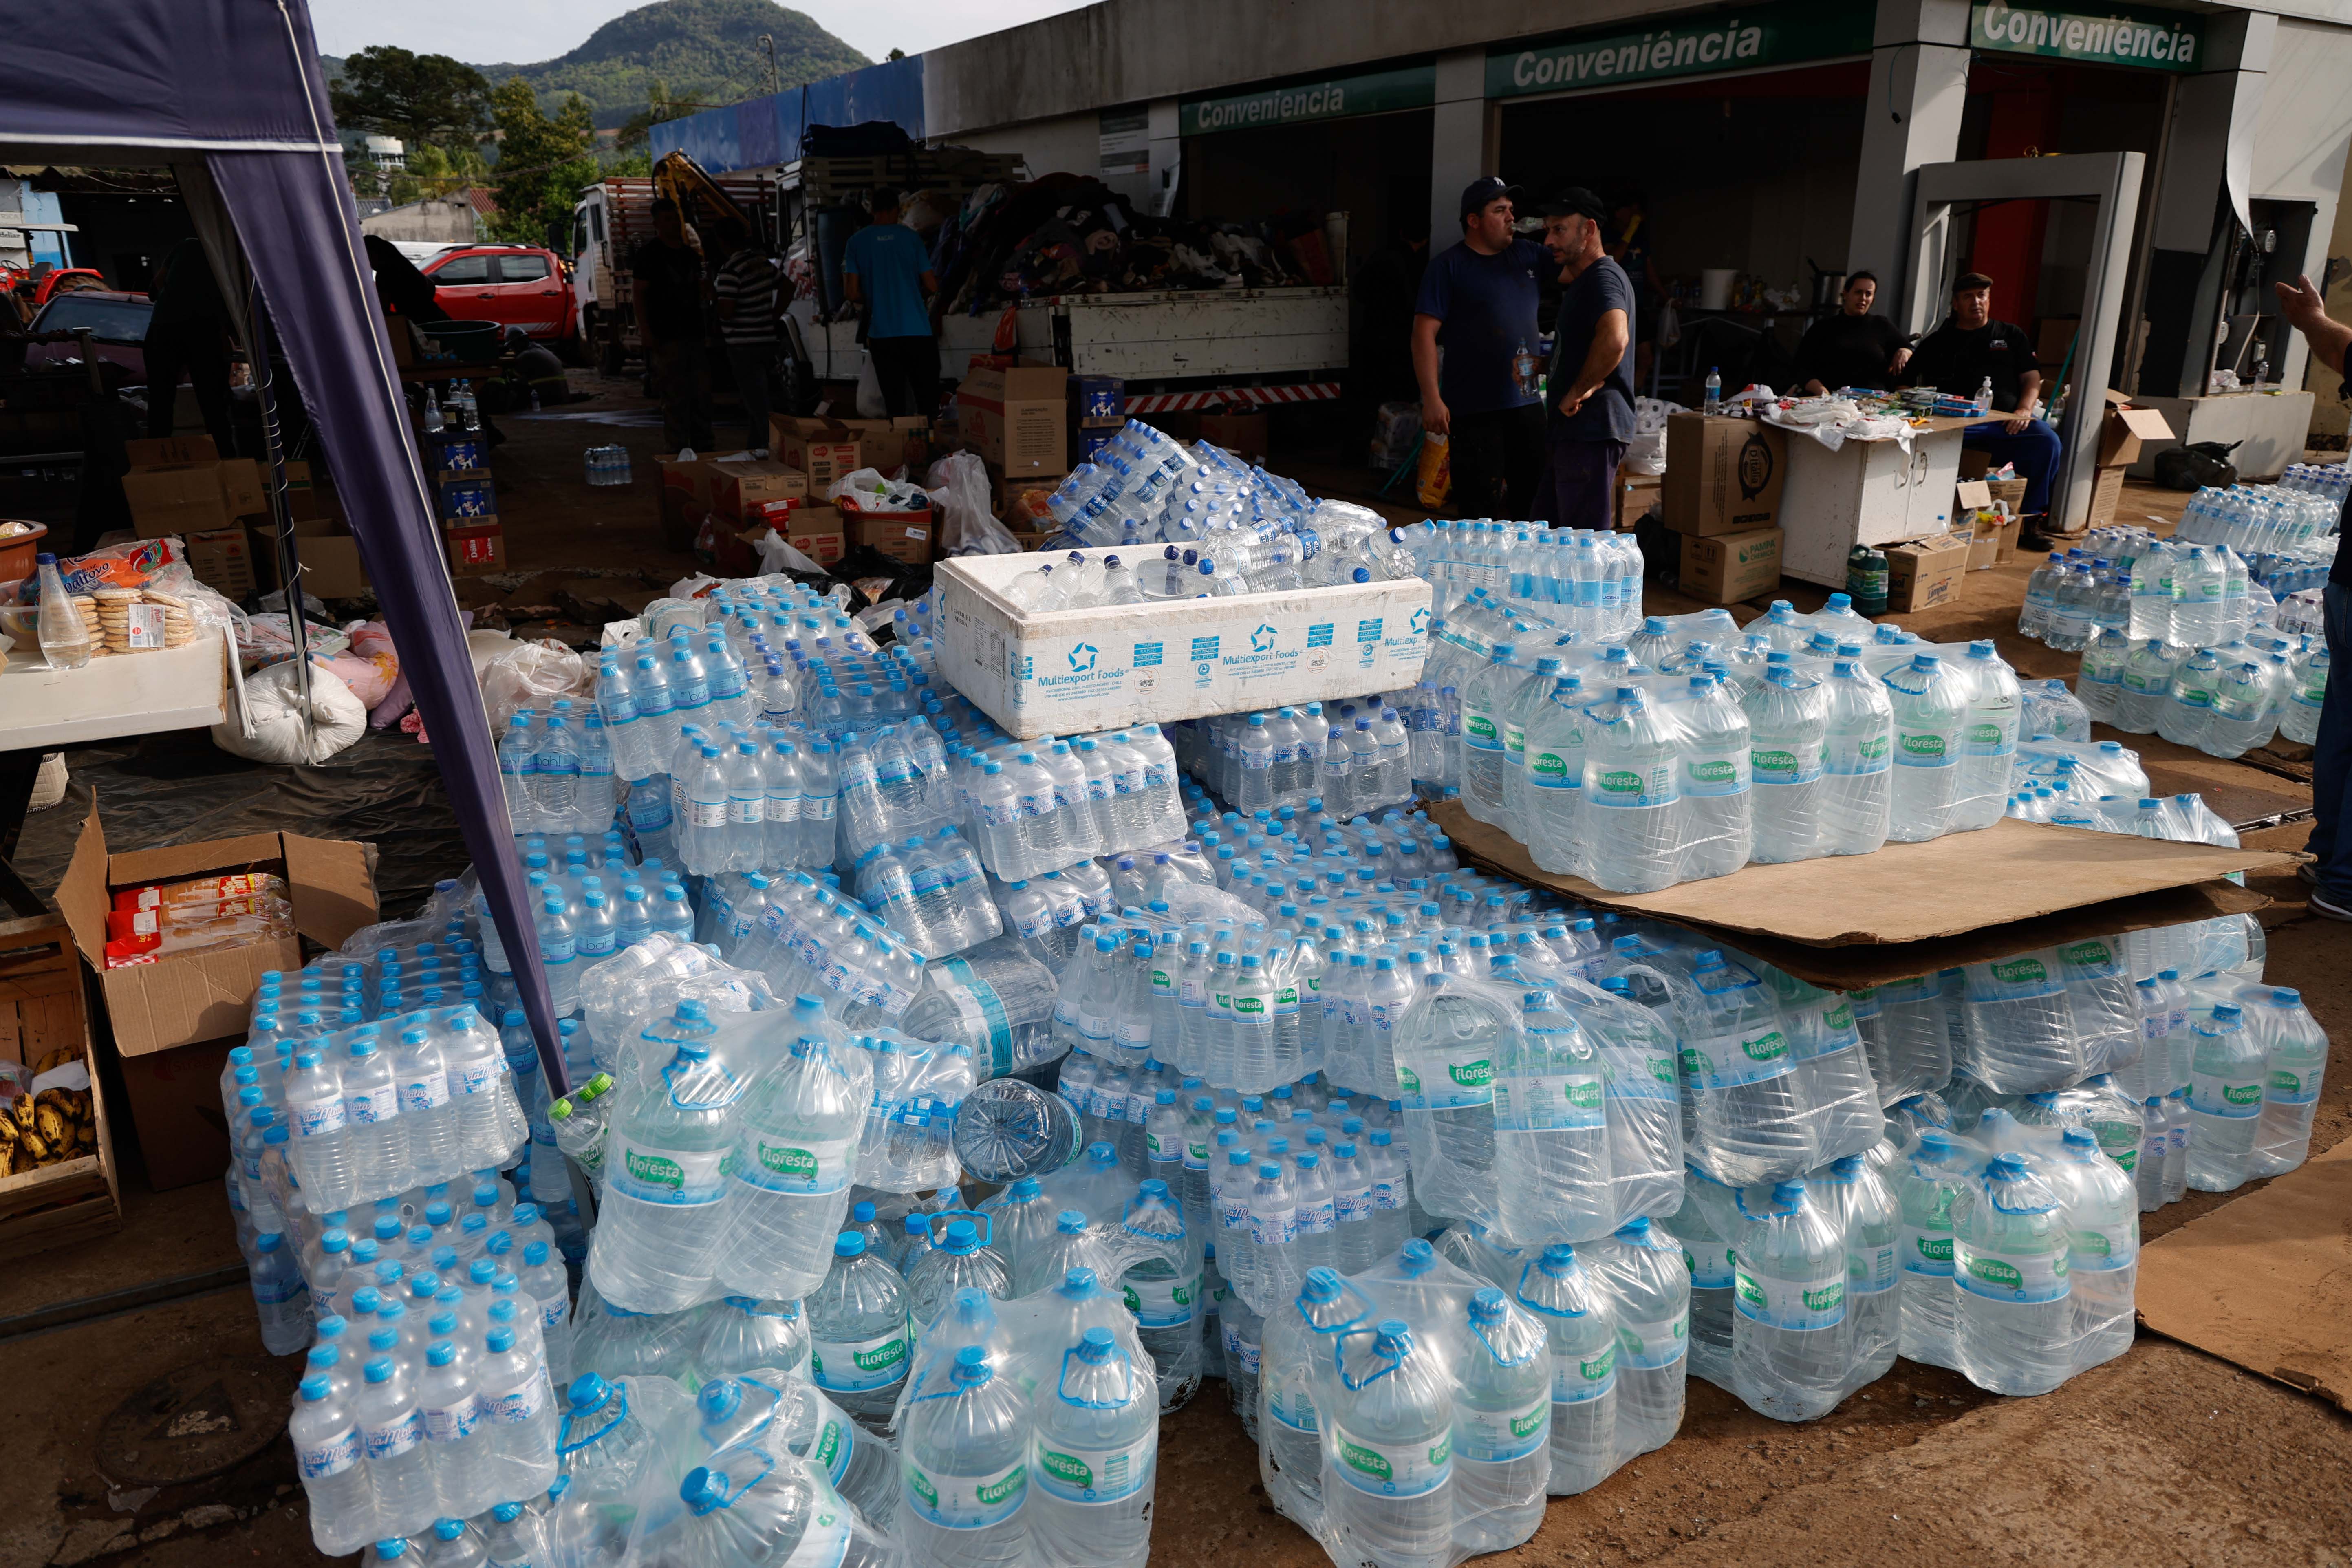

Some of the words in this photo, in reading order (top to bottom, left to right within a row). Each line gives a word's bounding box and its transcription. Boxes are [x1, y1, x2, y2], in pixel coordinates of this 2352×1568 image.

[1984, 0, 2196, 63] Conveniência
[1512, 19, 1762, 88] Conveniência
[1750, 539, 1776, 552] PAMPA
[64, 562, 109, 593] Dalfovo
[1927, 583, 1949, 600] Limpol
[953, 608, 972, 622] GABRIEL
[954, 616, 968, 627] SERRA
[1223, 653, 1272, 666] Multiexport
[1276, 648, 1298, 658] Foods
[1039, 670, 1095, 687] Multiexport
[1098, 668, 1124, 679] Foods
[689, 686, 709, 701] bah
[1058, 692, 1109, 702] www.multiexportfoods.com
[2186, 690, 2208, 699] floresta
[1466, 719, 1492, 730] loresta
[1969, 728, 1999, 738] oresta
[1904, 735, 1943, 748] floresta
[1532, 757, 1563, 769] loresta
[1753, 752, 1794, 765] floresta
[1692, 762, 1733, 774] floresta
[1600, 774, 1640, 786] floresta
[1997, 960, 2042, 977] floresta
[1235, 999, 1262, 1010] floresta
[1829, 1011, 1849, 1025] flores
[1748, 1039, 1785, 1056] floresta
[1651, 1063, 1671, 1075] flore
[1571, 1087, 1598, 1100] flores
[2228, 1086, 2260, 1100] floresta
[762, 1147, 815, 1169] floresta
[629, 1155, 680, 1178] floresta
[1922, 1242, 1955, 1255] flore
[1966, 1260, 2017, 1280] floresta
[1809, 1287, 1843, 1305] floresta
[860, 1341, 904, 1366] floresta
[1338, 1442, 1387, 1469] floresta
[1041, 1452, 1087, 1476] loresta
